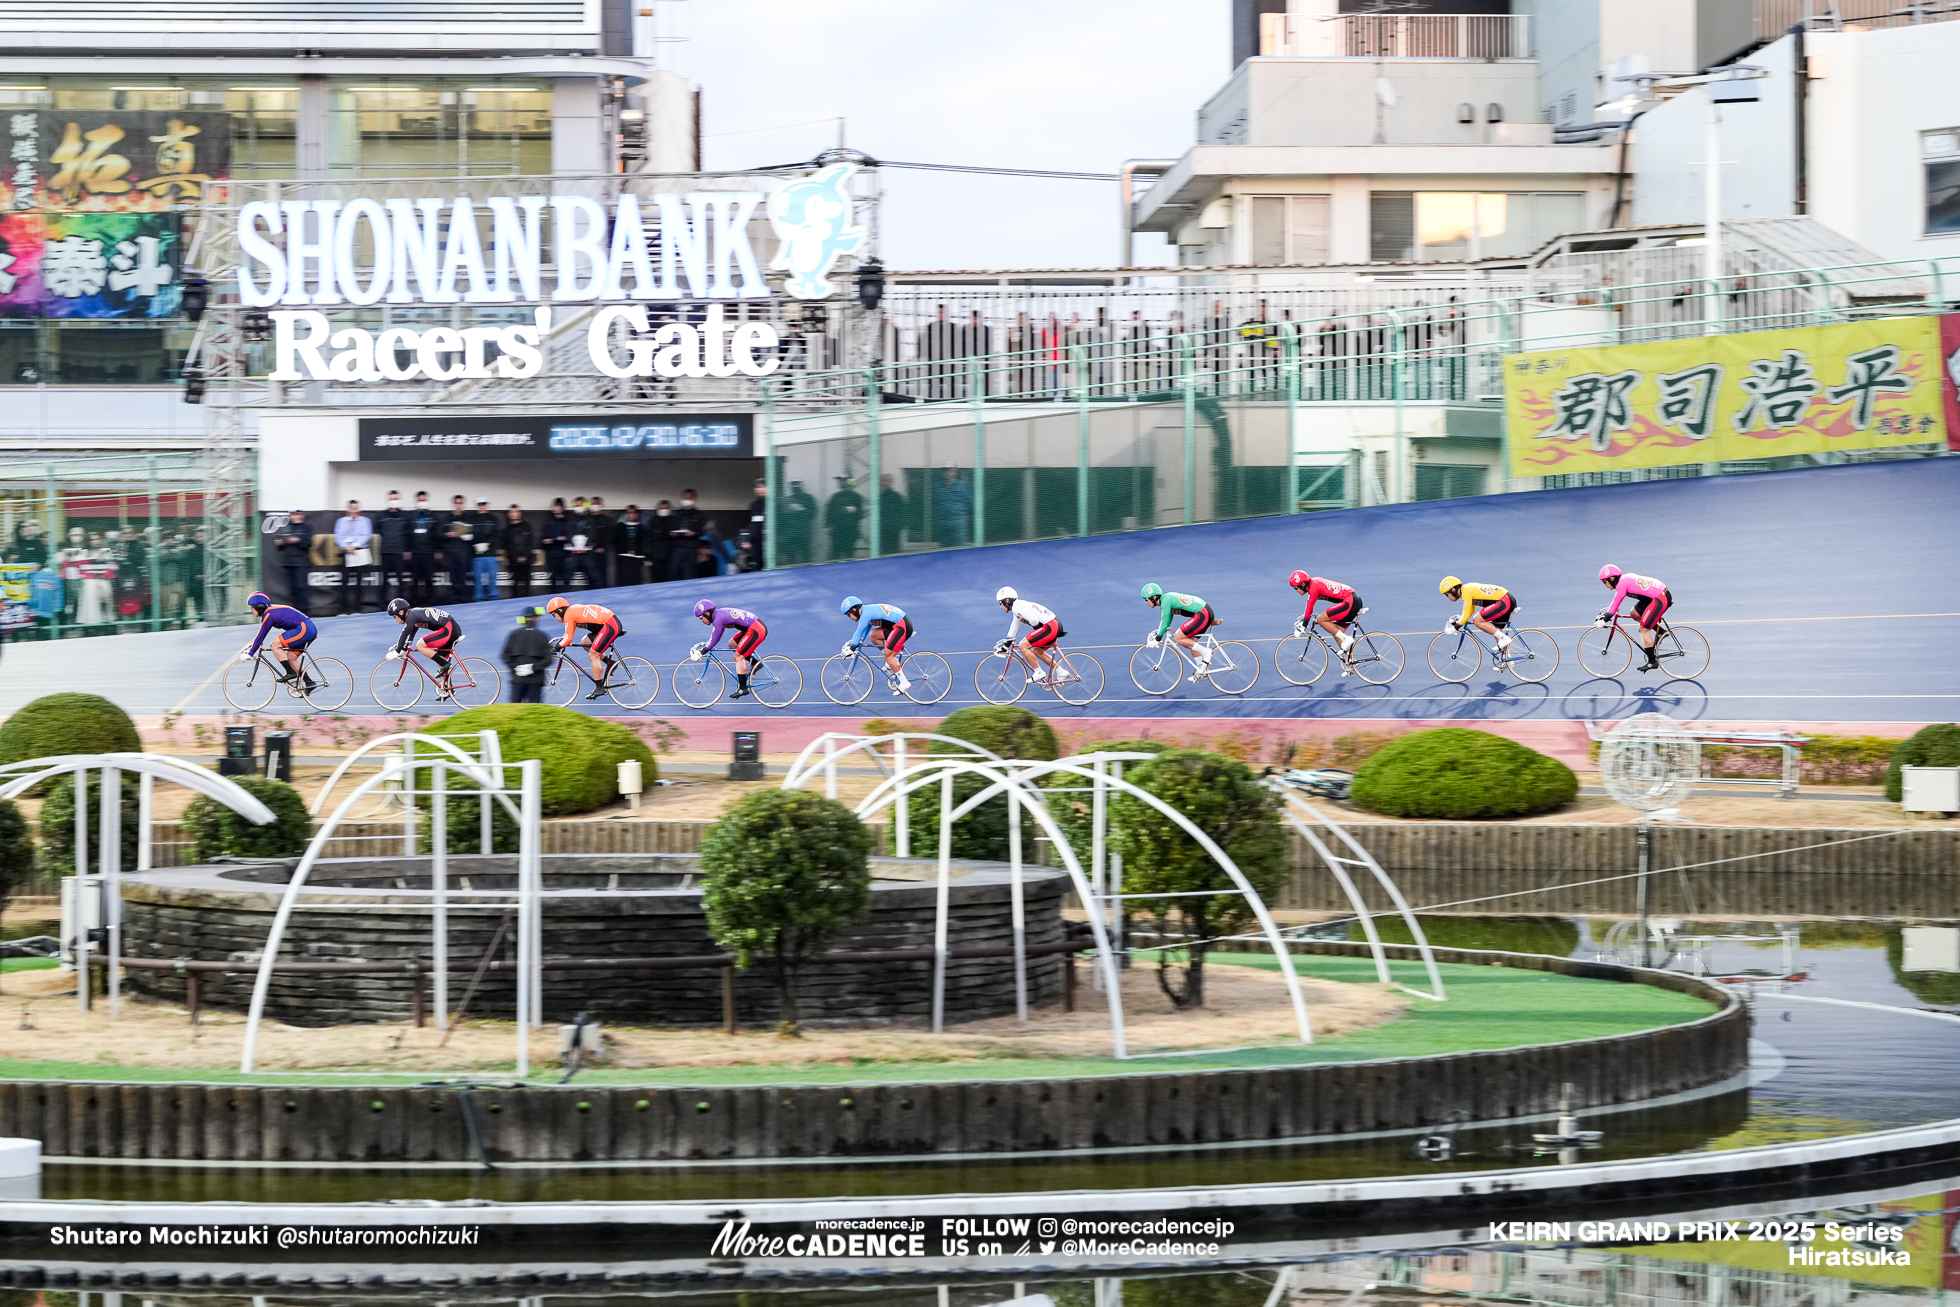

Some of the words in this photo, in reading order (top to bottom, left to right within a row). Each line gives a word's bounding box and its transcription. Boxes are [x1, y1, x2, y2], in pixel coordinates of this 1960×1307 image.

[237, 195, 541, 307] SHONAN
[550, 191, 771, 300] BANK
[268, 305, 551, 382] Racers'
[587, 304, 781, 379] Gate
[1534, 344, 1916, 452] 郡司浩平
[1326, 581, 1341, 594] 3
[1636, 578, 1651, 590] 8
[1178, 595, 1193, 606] 6
[425, 608, 440, 621] 2
[583, 606, 599, 619] 7
[730, 609, 746, 621] 9
